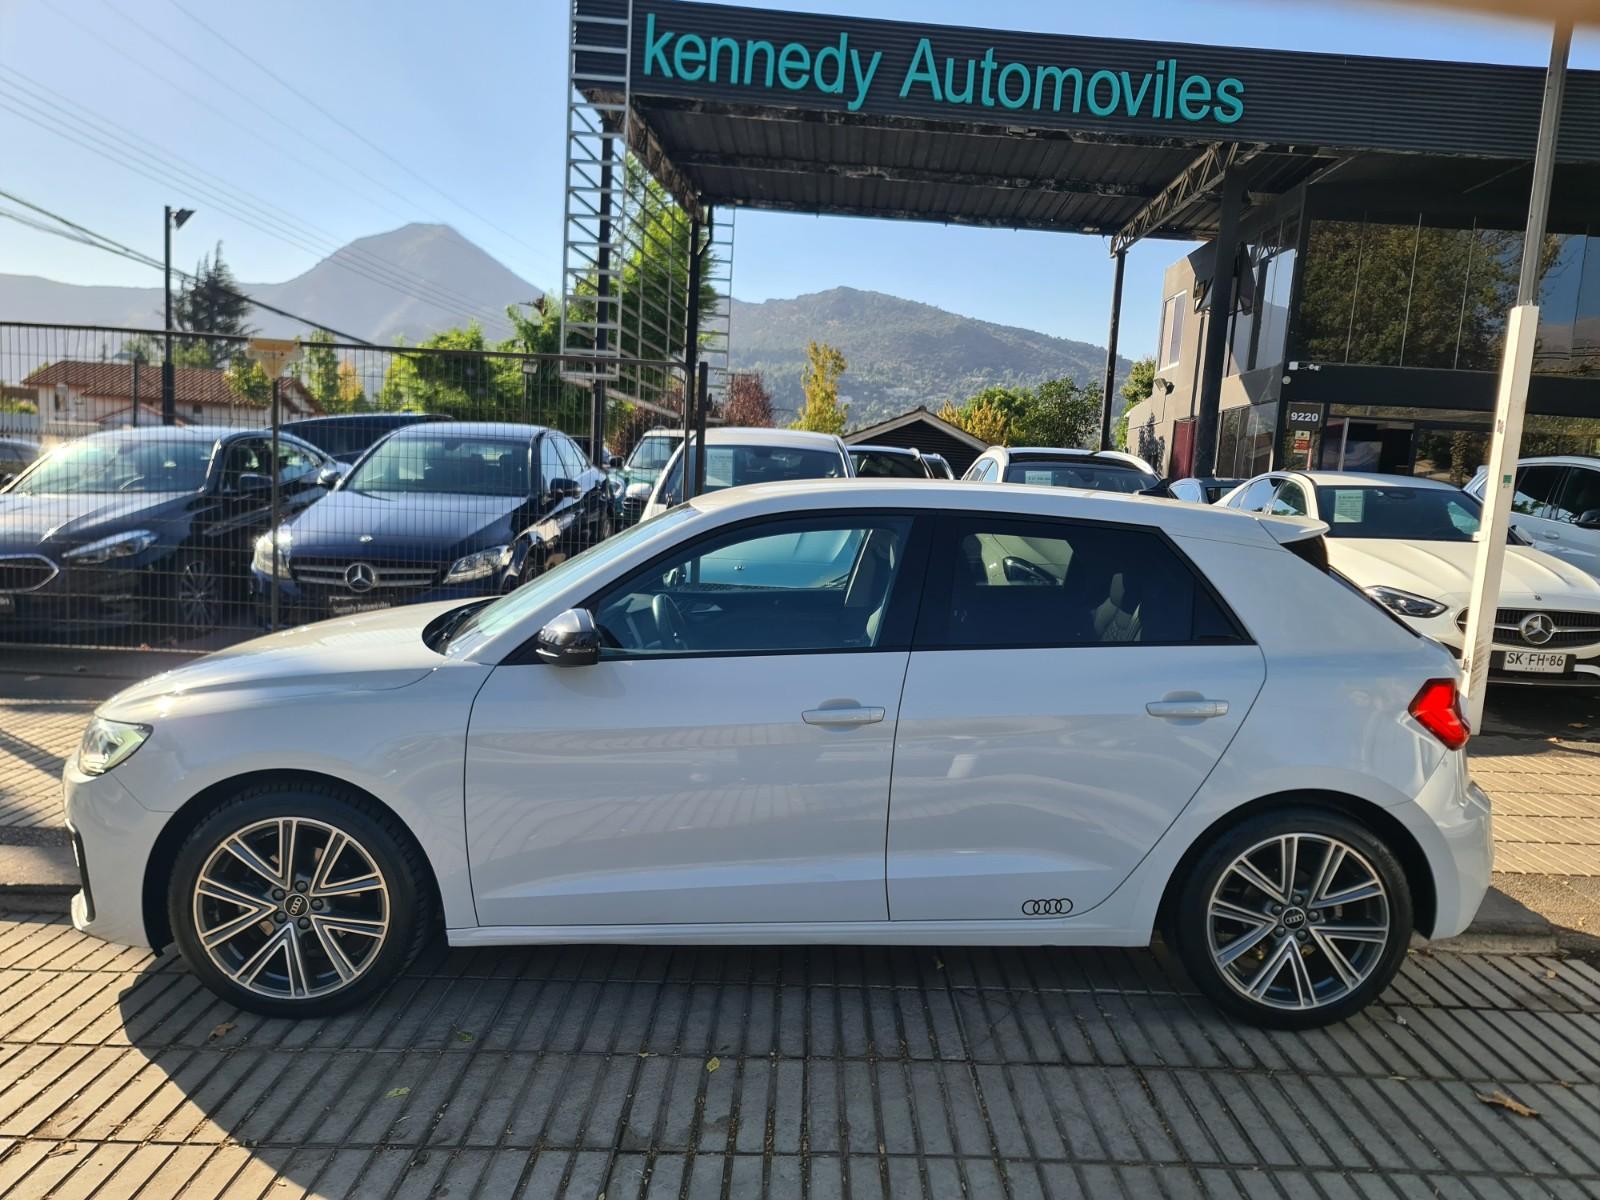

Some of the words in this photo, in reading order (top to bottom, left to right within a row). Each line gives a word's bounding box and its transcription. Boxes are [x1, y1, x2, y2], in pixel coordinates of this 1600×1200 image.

[643, 12, 882, 111] kennedy
[899, 37, 1245, 124] Automoviles
[1291, 411, 1319, 422] 9220
